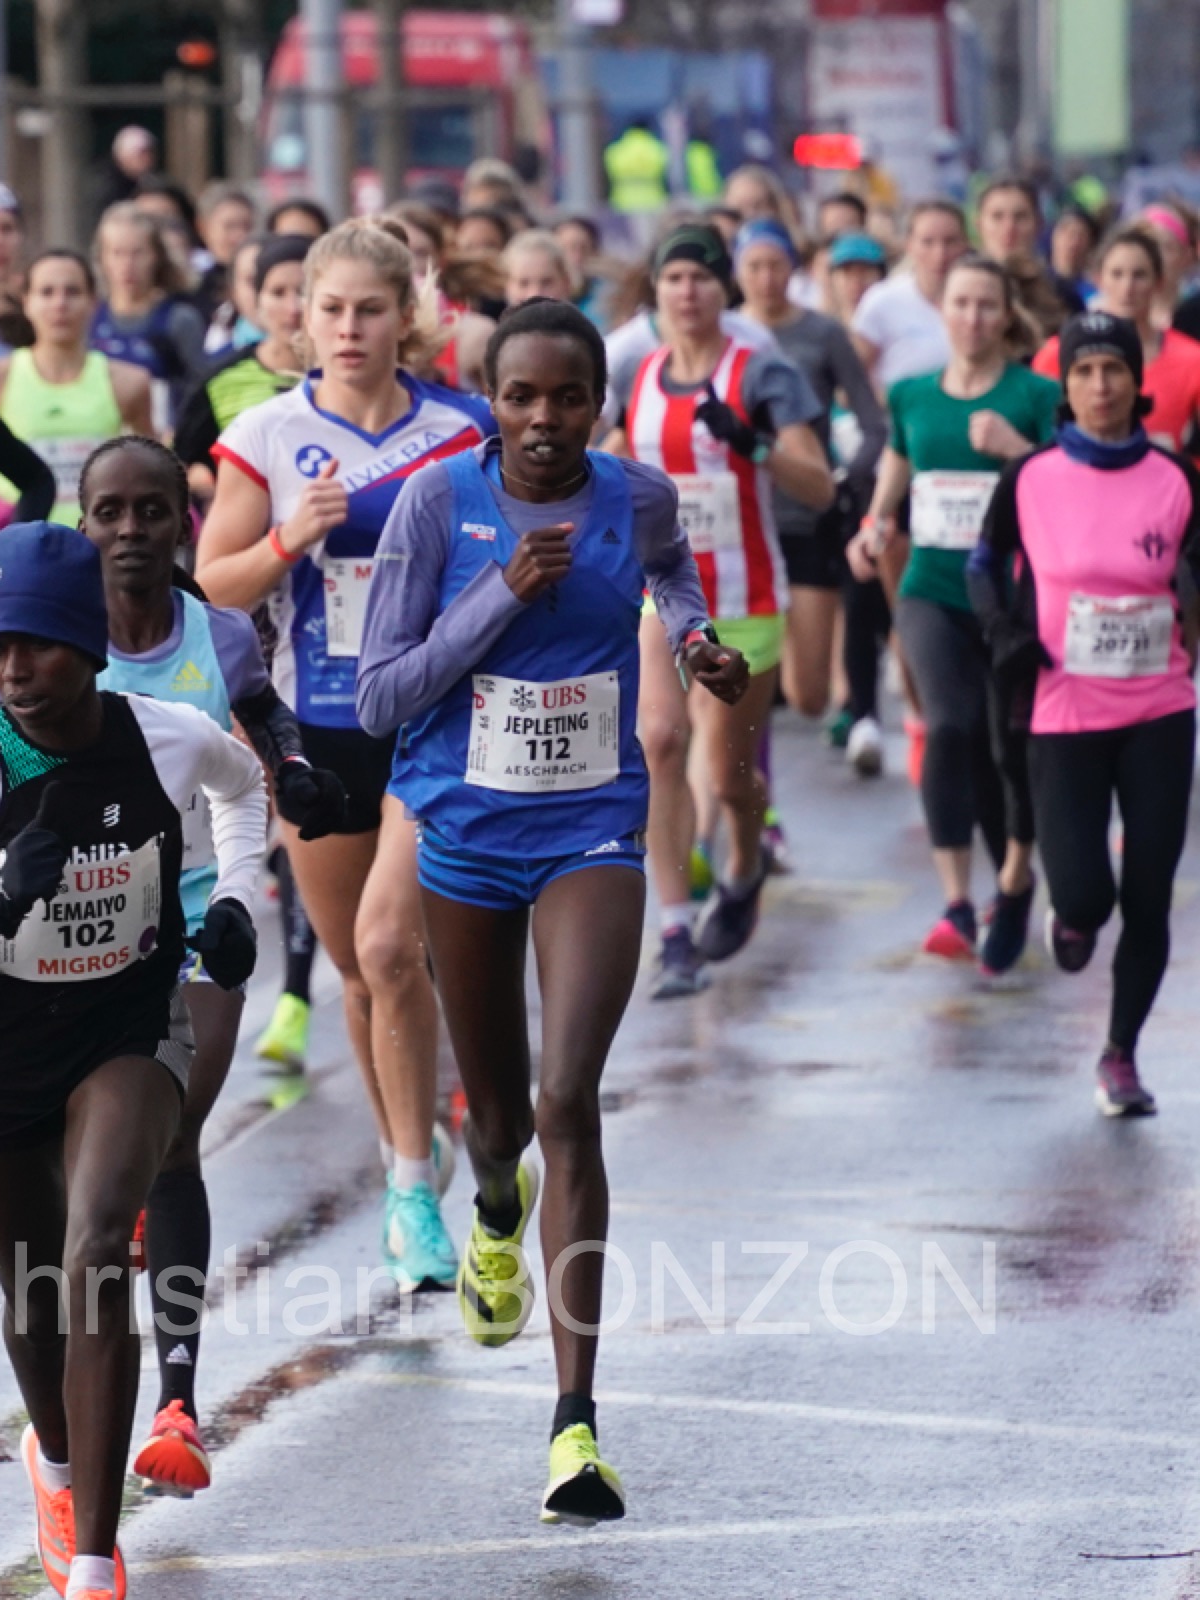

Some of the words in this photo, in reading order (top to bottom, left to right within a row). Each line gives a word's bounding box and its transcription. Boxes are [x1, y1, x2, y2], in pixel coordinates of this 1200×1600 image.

[541, 683, 587, 710] UBS
[503, 711, 589, 736] JEPLETING
[525, 737, 571, 761] 112
[503, 761, 588, 777] AESCHBACH
[73, 861, 131, 893] UBS
[41, 894, 127, 922] JEMAIYO
[57, 920, 116, 949] 102
[37, 946, 131, 976] MIGROS
